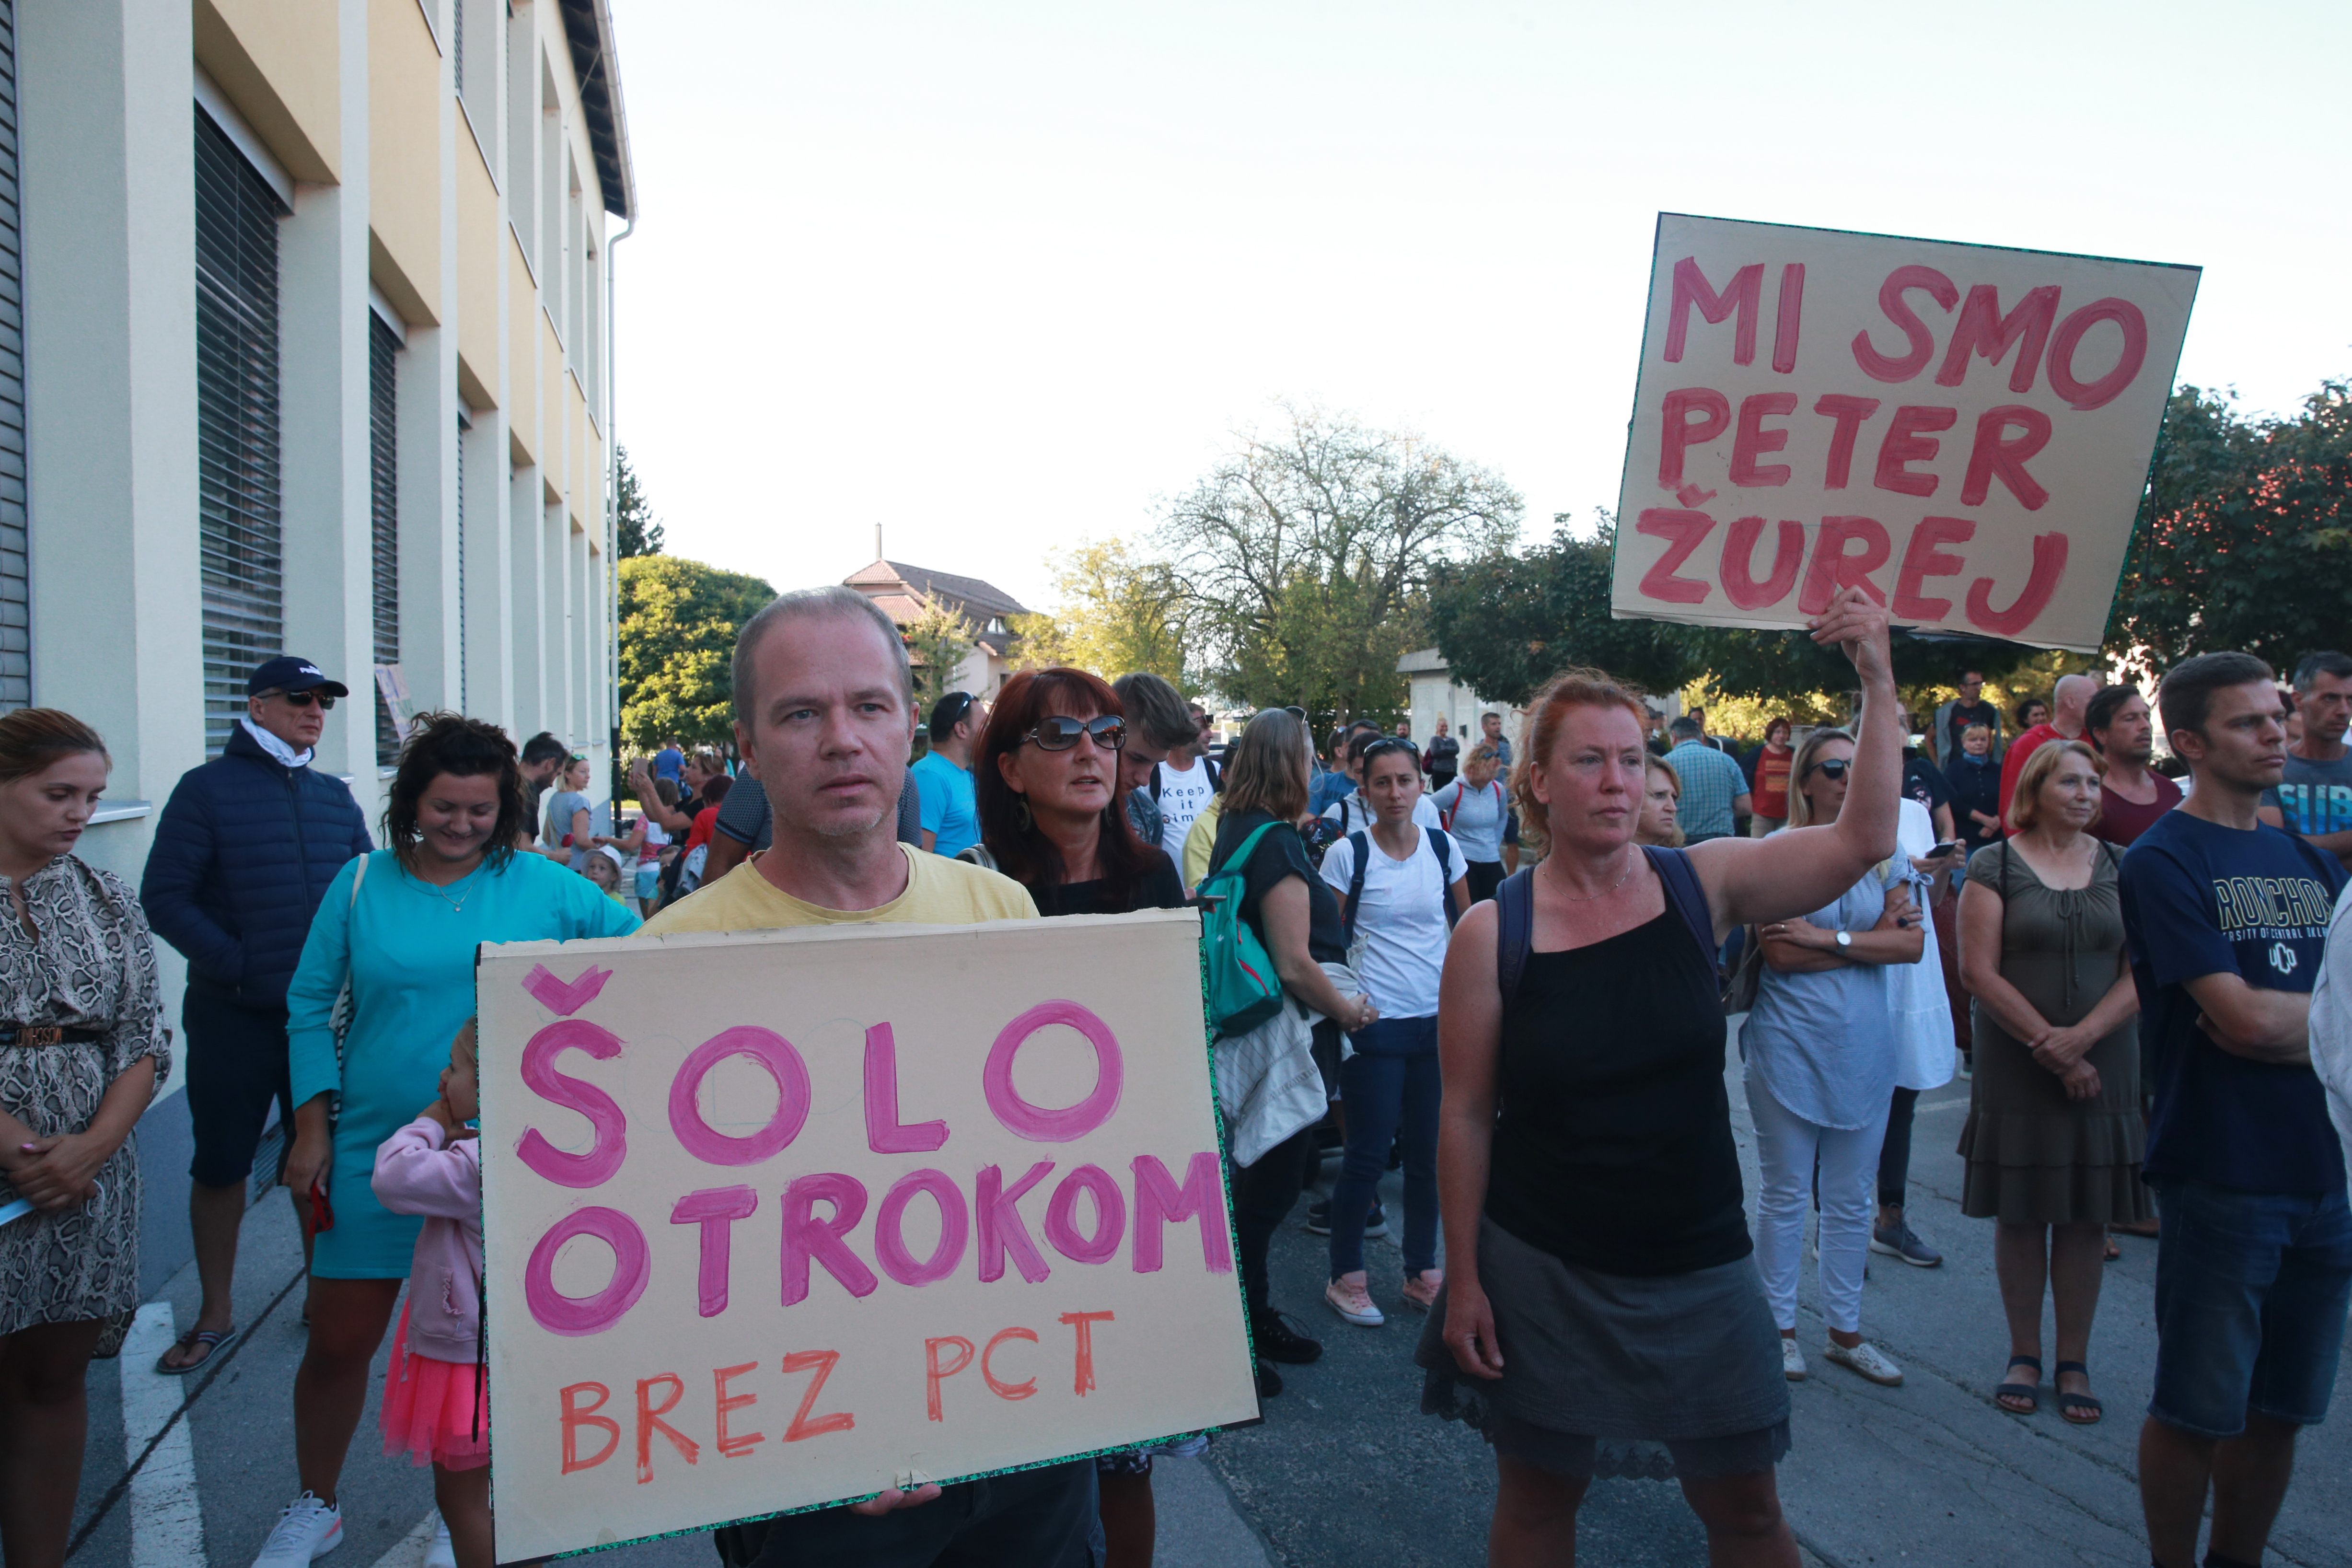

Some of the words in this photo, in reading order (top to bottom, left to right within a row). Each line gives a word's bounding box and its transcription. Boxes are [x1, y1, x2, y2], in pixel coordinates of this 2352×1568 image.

[1663, 256, 1806, 374] MI
[1851, 264, 2148, 410] SMO
[1658, 386, 2053, 511] PETER
[1635, 483, 2069, 636] ŽUREJ
[1162, 787, 1204, 798] Keep
[1162, 813, 1199, 824] Sim
[1181, 800, 1193, 810] it
[2269, 942, 2298, 975] UCO
[2271, 928, 2303, 939] CENTRAL
[516, 963, 1124, 1189] ŠOLO
[524, 1151, 1233, 1337] OTROKOM
[559, 1349, 855, 1485] BREZ
[925, 1310, 1115, 1422] PCT
